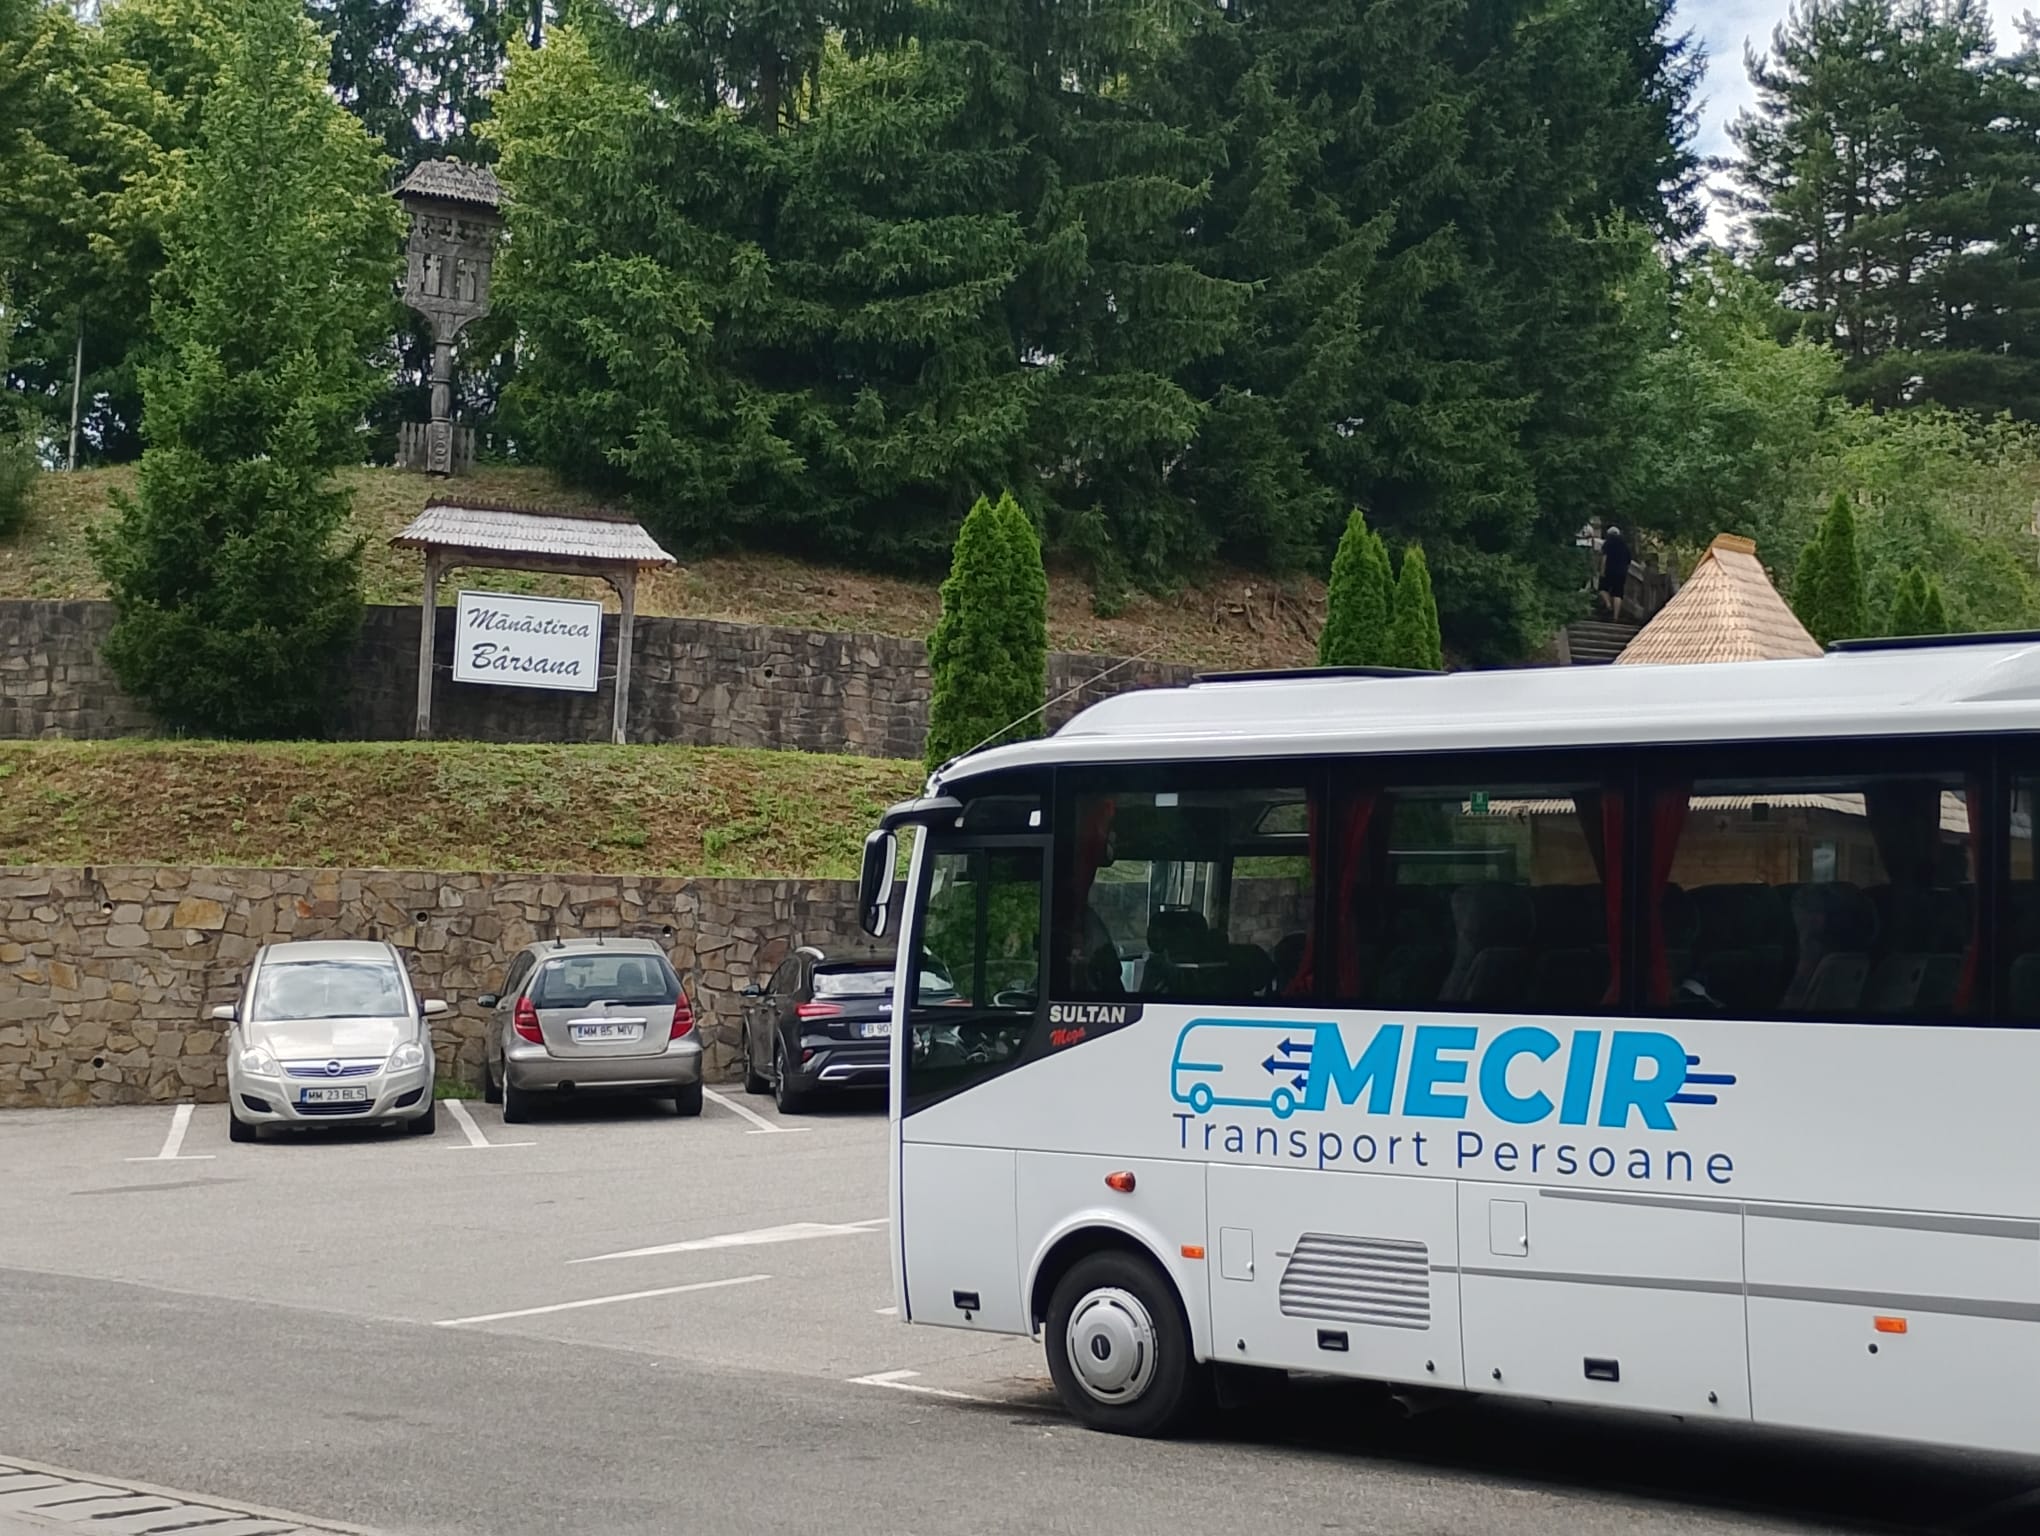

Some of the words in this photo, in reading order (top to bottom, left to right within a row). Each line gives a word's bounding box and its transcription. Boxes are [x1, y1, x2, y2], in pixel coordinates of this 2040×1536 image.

[471, 642, 582, 676] Bârsana
[1049, 1004, 1126, 1024] SULTAN
[1049, 1026, 1087, 1047] Mega
[1303, 1022, 1687, 1131] MECIR
[327, 1089, 340, 1101] 23
[342, 1089, 365, 1100] BLS
[1172, 1113, 1428, 1170] Transport
[1456, 1130, 1734, 1185] Persoane
